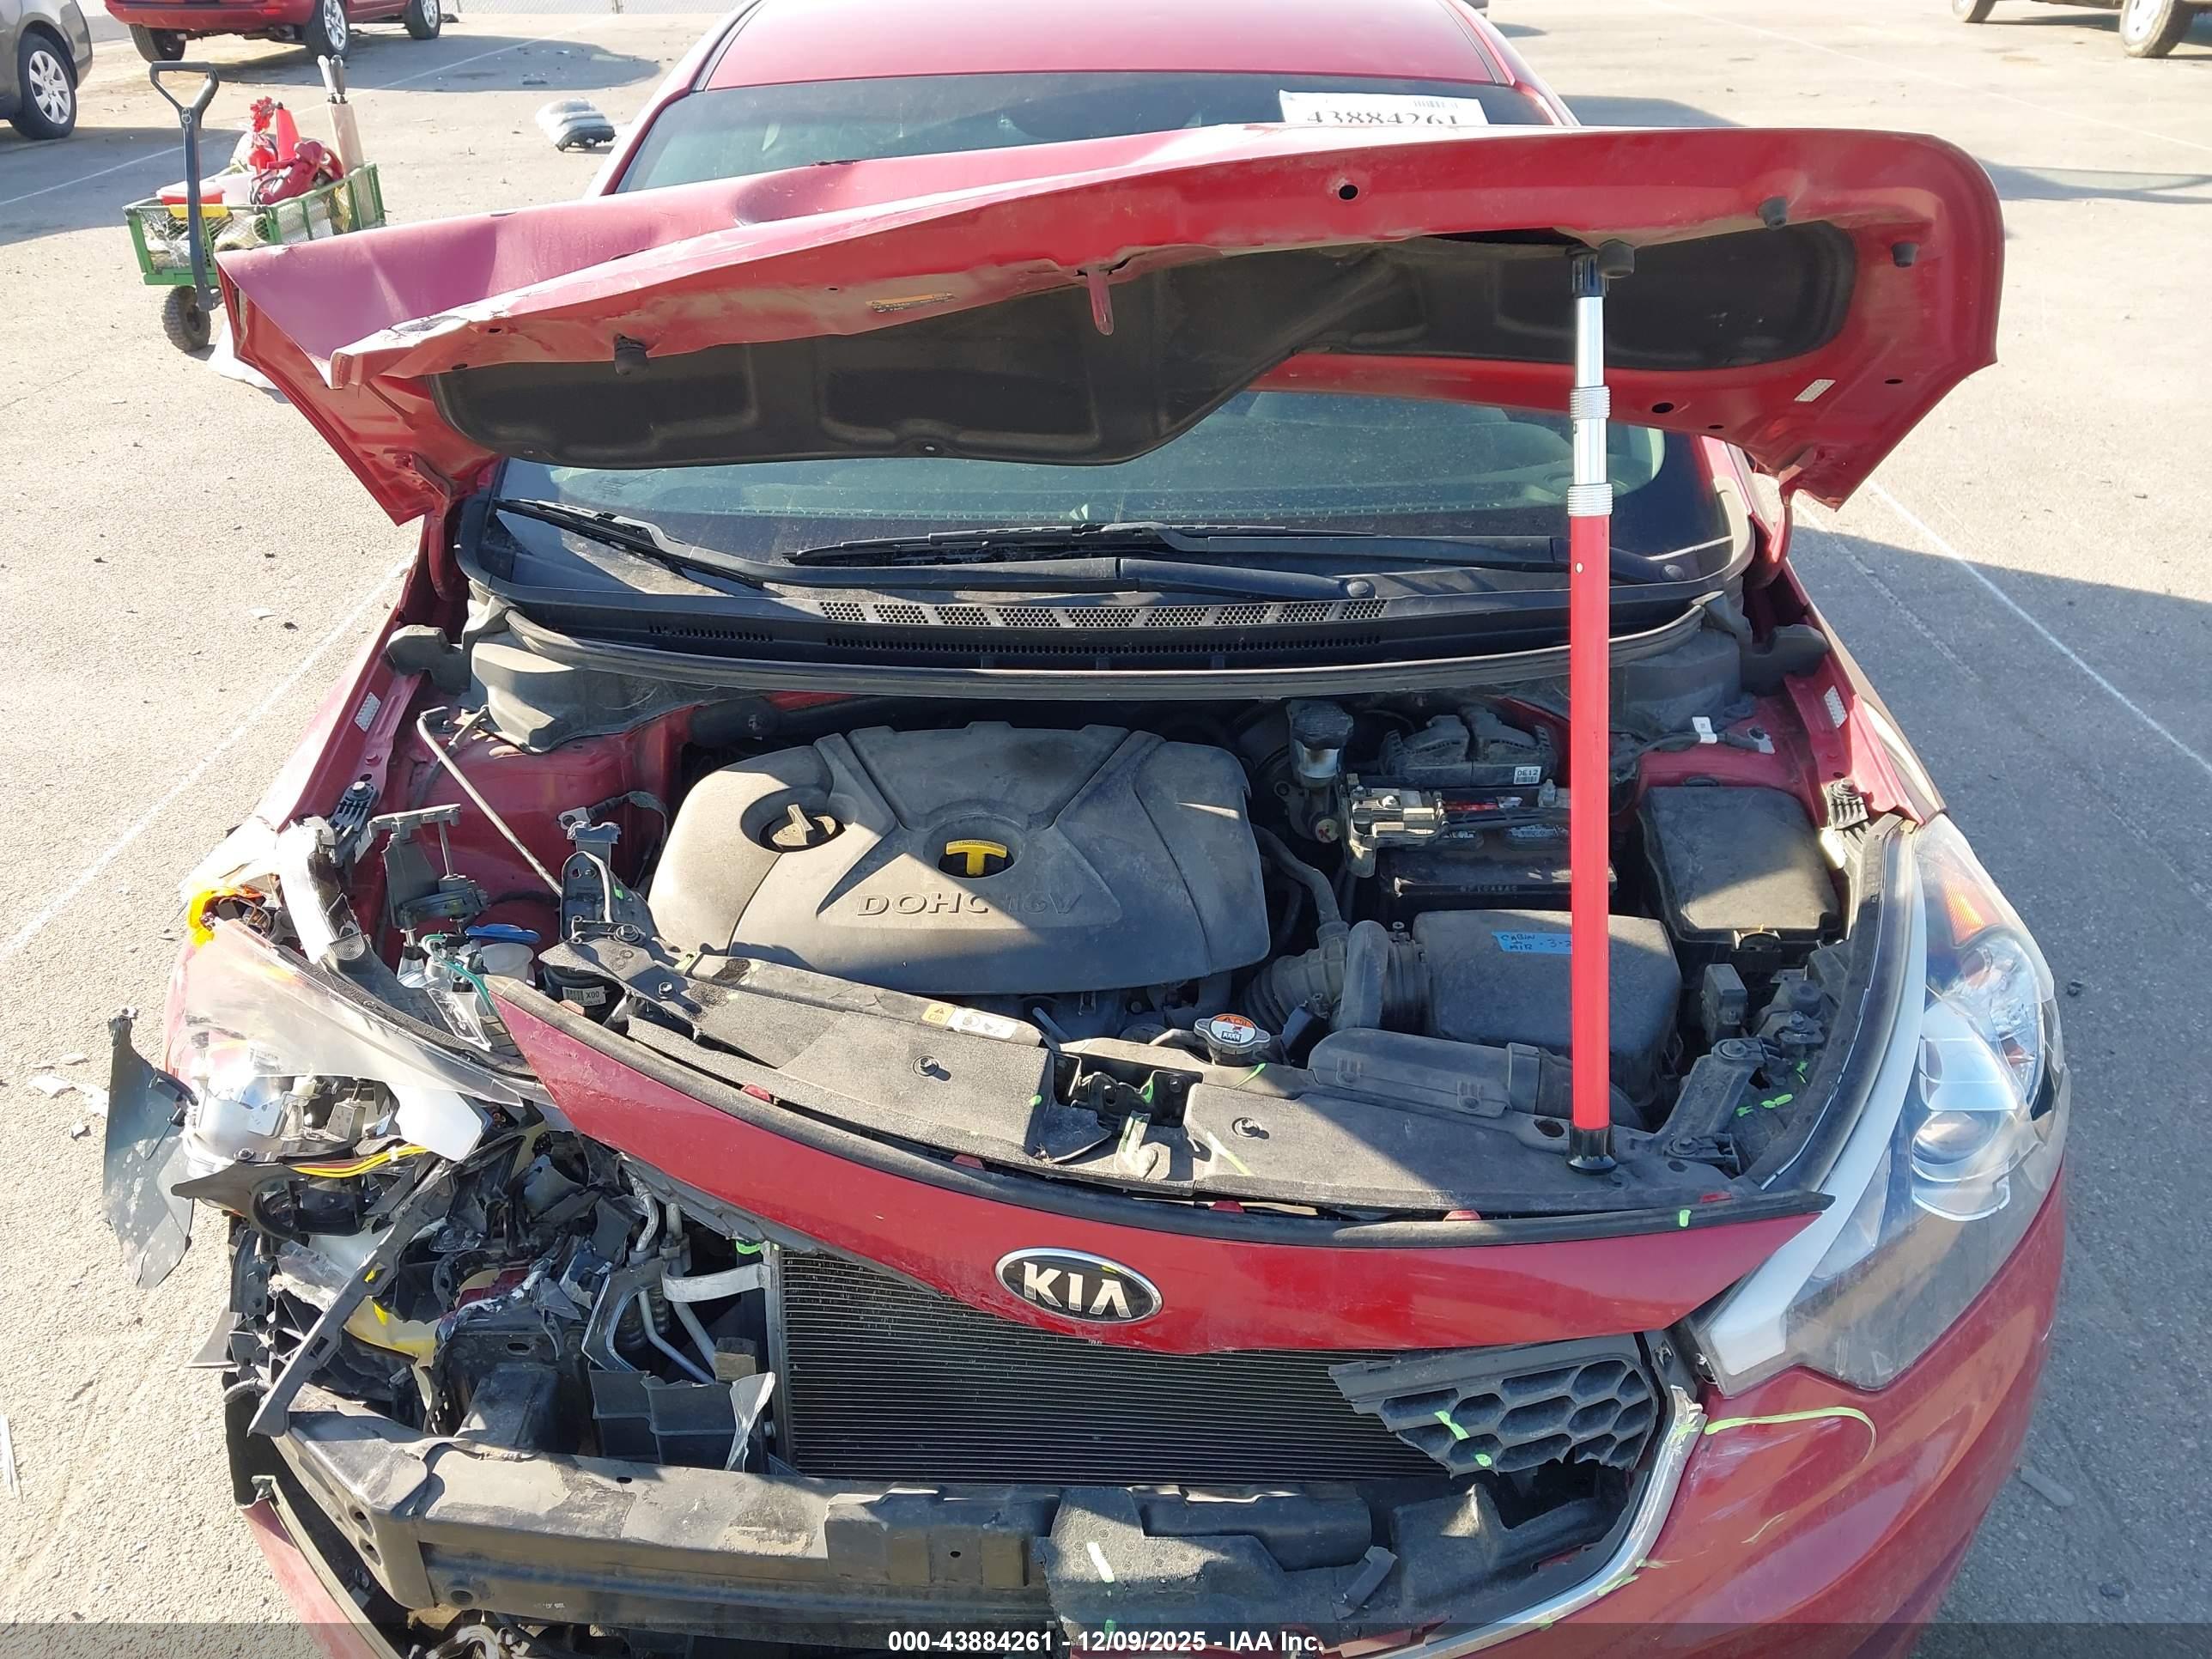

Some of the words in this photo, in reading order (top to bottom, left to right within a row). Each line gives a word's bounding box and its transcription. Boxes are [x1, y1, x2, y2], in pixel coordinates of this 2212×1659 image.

[857, 892, 990, 916] DOHC
[1006, 892, 1083, 915] 16V
[1024, 1261, 1132, 1318] KIA
